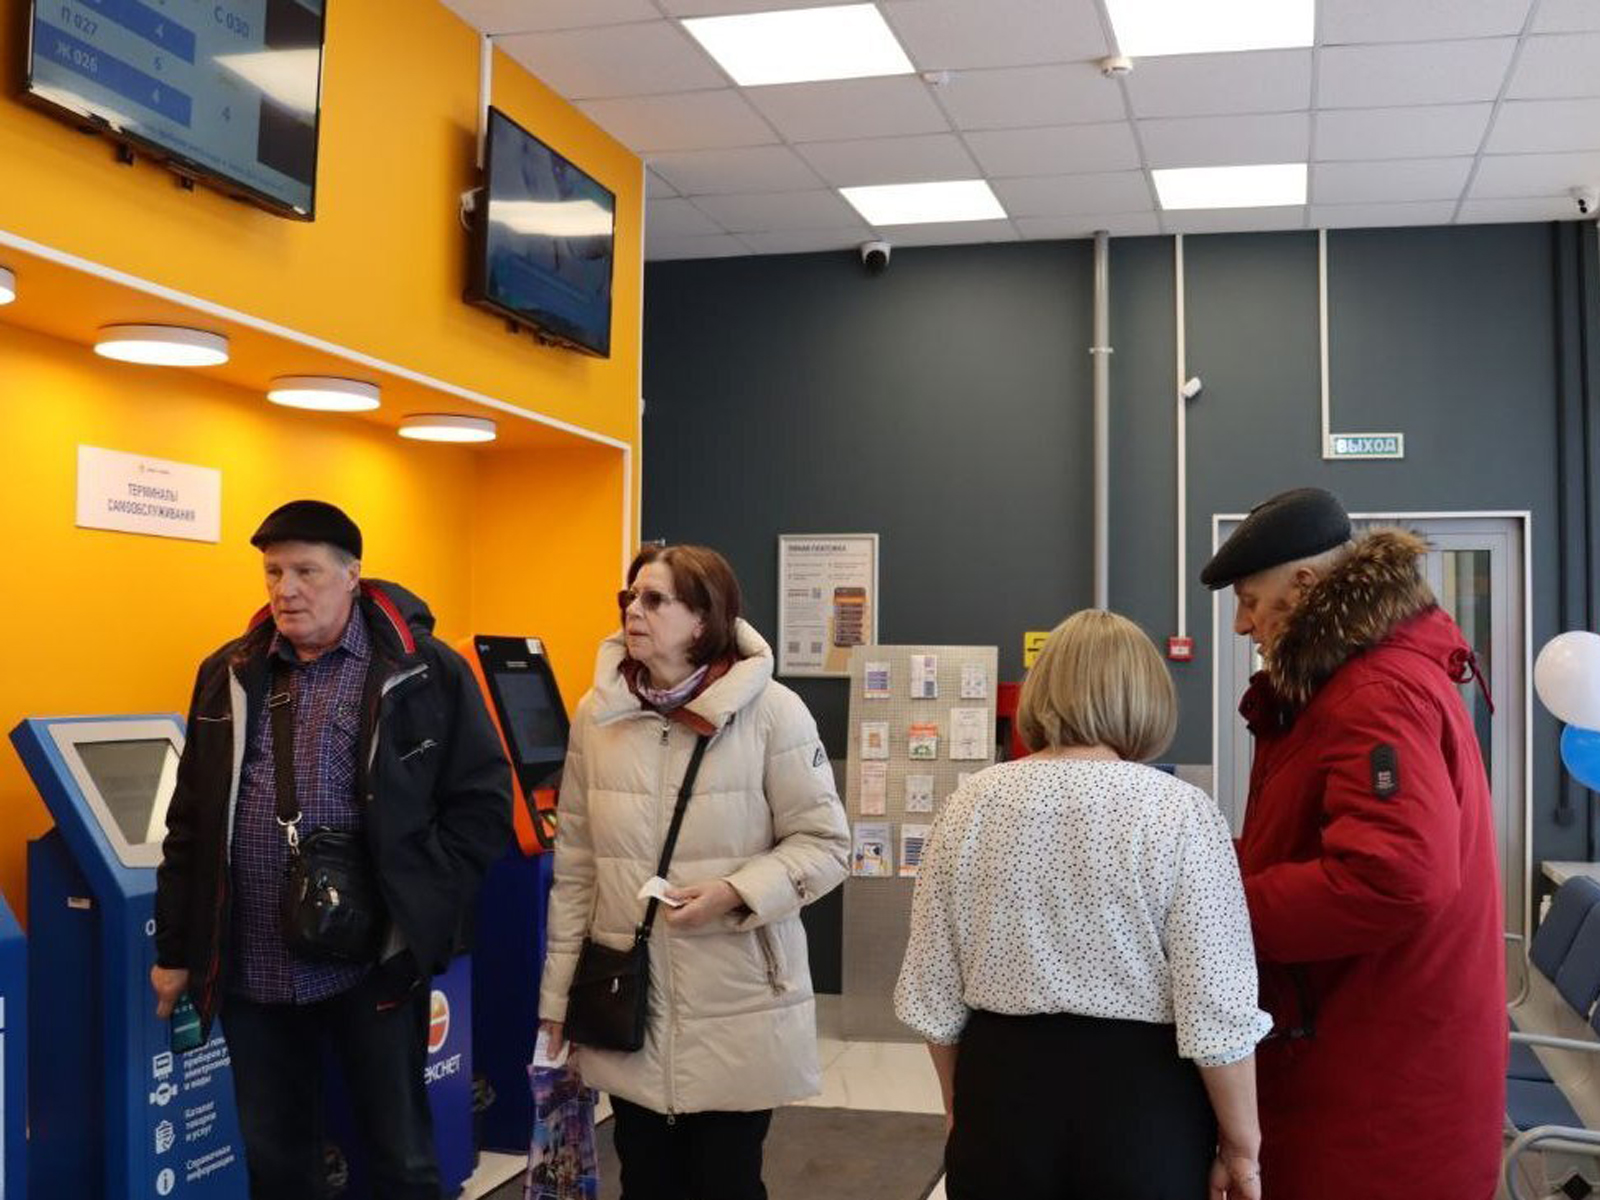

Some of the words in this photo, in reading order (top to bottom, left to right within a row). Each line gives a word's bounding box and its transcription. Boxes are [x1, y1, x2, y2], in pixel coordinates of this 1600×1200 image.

[61, 6, 70, 24] П
[73, 12, 98, 37] 027
[73, 49, 98, 73] 026
[1336, 438, 1397, 453] ВЫХОД
[128, 483, 178, 502] ТЕРМИНАЛЫ
[107, 499, 195, 521] САМООБСЛУЖИВАНИЯ
